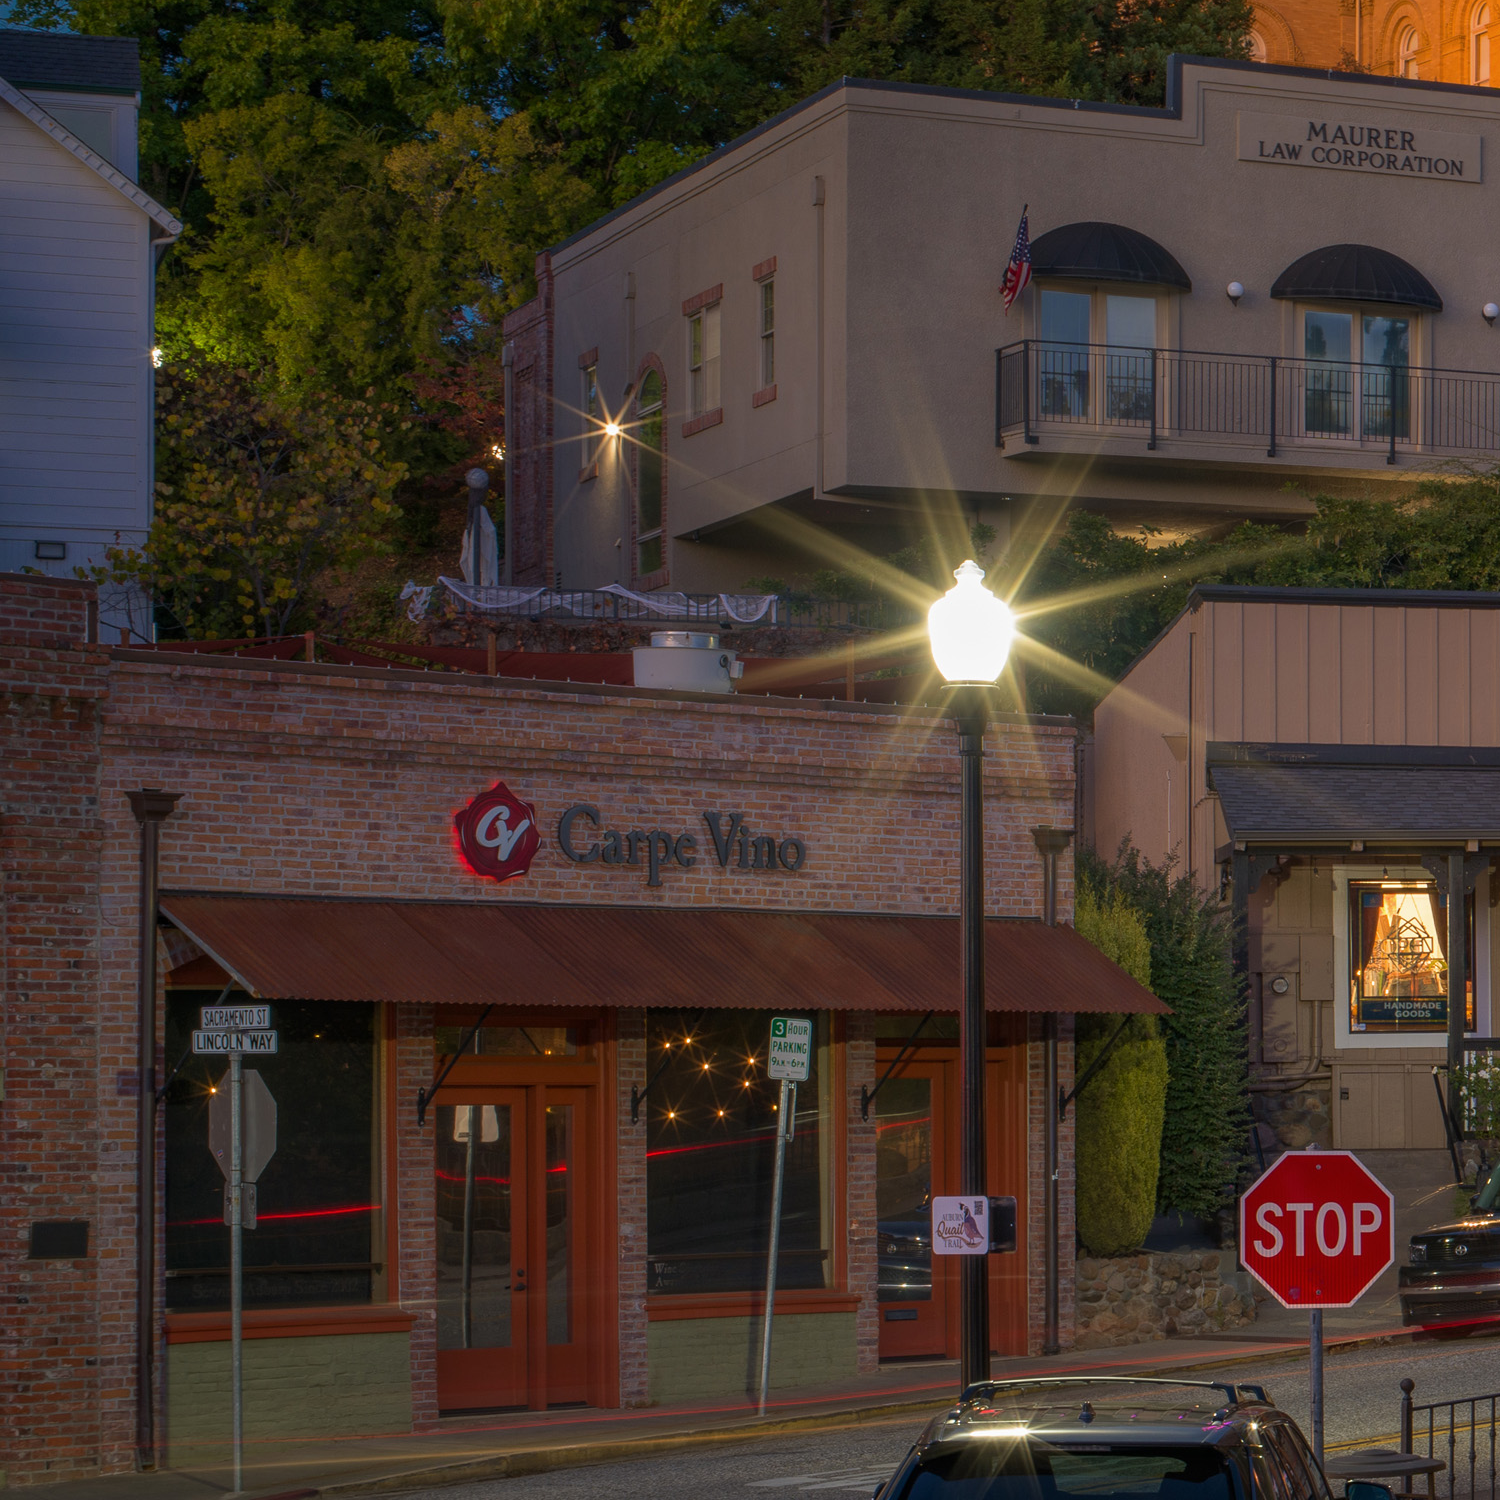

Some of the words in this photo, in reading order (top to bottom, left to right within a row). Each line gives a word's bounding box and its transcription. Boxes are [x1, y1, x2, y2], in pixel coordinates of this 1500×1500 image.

[1307, 122, 1417, 152] MAURER
[1258, 141, 1304, 161] LAW
[1311, 146, 1464, 177] CORPORATION
[558, 803, 697, 887] Carpe
[703, 810, 806, 871] Vino
[1384, 1002, 1442, 1010] HANDMADE
[1394, 1010, 1431, 1018] GOODS
[204, 1009, 254, 1026] SACRAMENTO
[257, 1008, 266, 1025] ST
[775, 1022, 784, 1035] 3
[788, 1024, 808, 1036] HOUR
[196, 1033, 243, 1050] LINCOLN
[249, 1033, 273, 1050] WAY
[772, 1040, 807, 1054] PARKING
[942, 1213, 964, 1221] AUBURN
[935, 1220, 964, 1237] Quail
[1254, 1202, 1383, 1258] STOP
[944, 1239, 963, 1249] TRAIL
